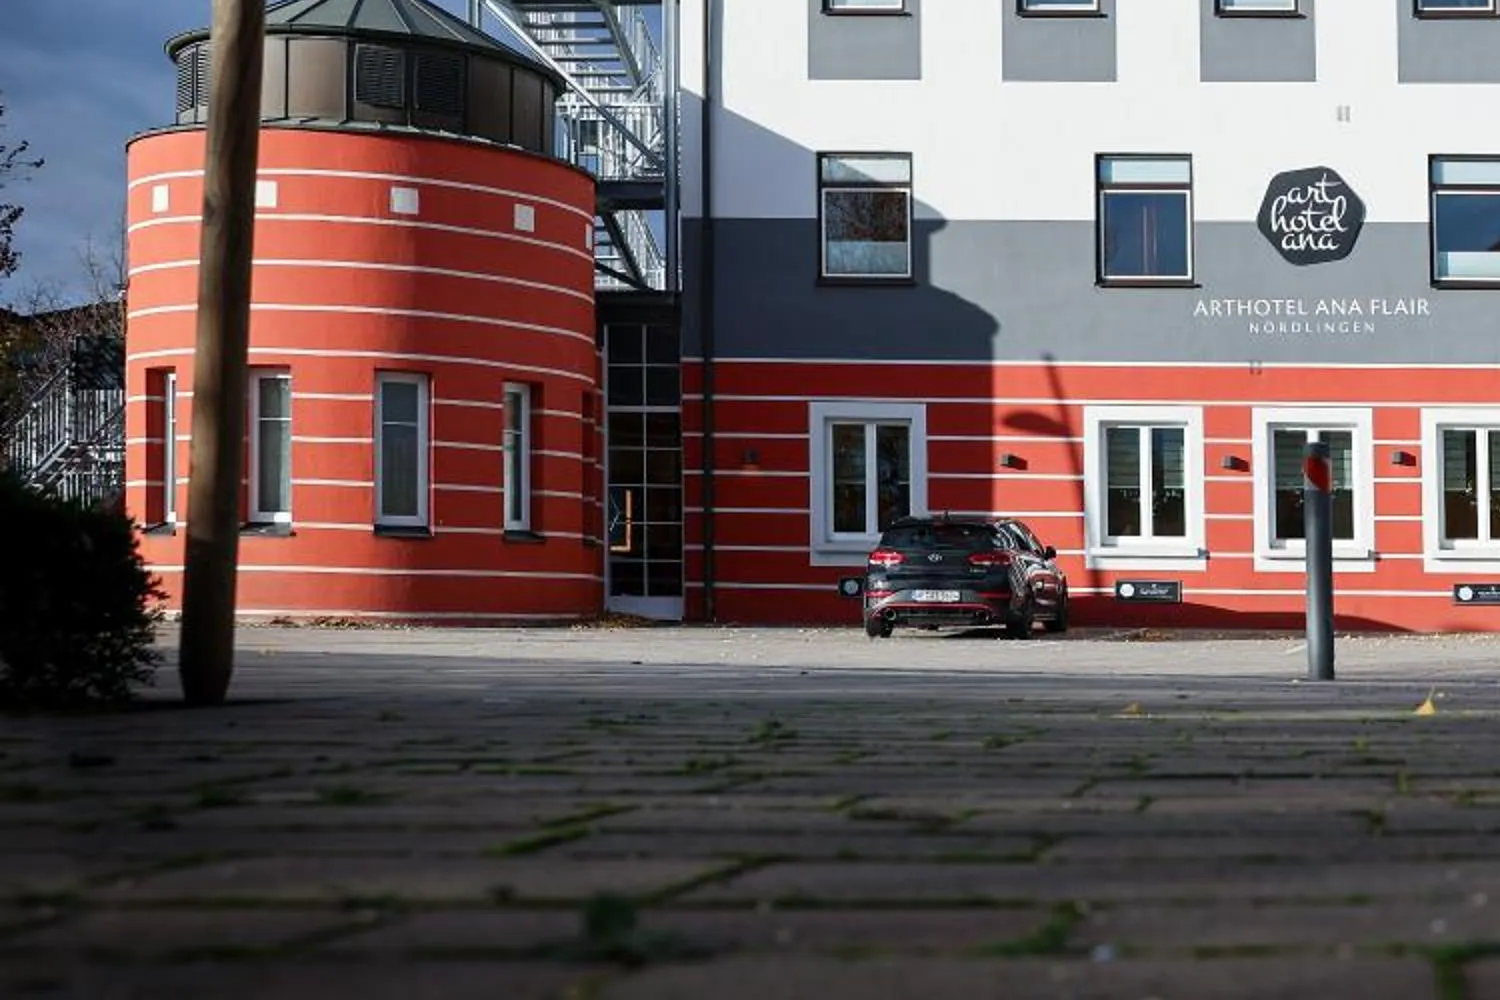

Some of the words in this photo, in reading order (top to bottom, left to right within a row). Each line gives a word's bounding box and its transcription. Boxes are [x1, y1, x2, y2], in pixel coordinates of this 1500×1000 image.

[1286, 174, 1341, 204] art
[1271, 195, 1349, 232] hotel
[1281, 232, 1340, 250] ana
[1193, 299, 1308, 316] ARTHOTEL
[1315, 299, 1363, 316] ANA
[1371, 299, 1430, 316] FLAIR
